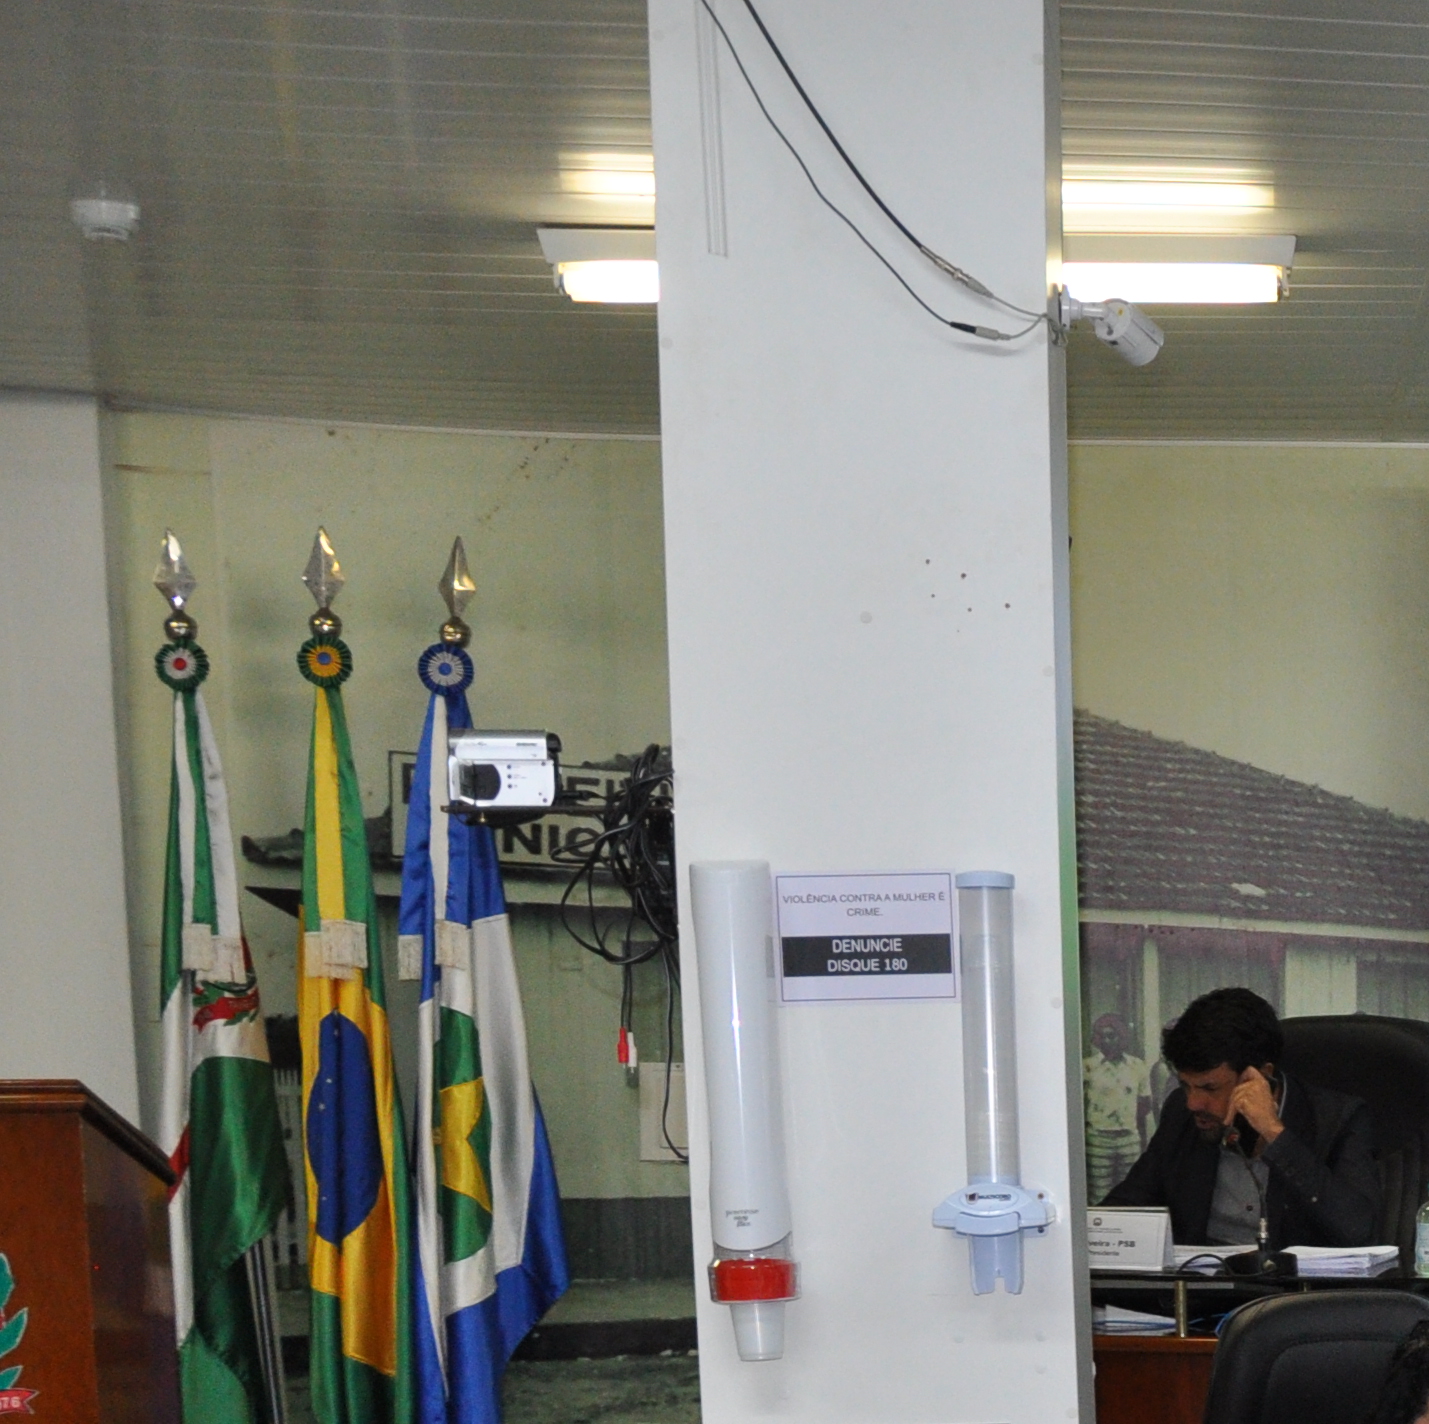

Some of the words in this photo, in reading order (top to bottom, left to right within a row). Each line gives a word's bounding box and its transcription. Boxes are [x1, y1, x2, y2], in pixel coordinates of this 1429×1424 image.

[783, 894, 836, 903] VIOLÊNCIA
[840, 894, 882, 902] CONTRA
[893, 892, 936, 901] MULHER
[939, 892, 944, 900] É
[847, 908, 883, 916] CRIME.
[832, 938, 902, 953] DENUNCIE
[827, 959, 880, 972] DISQUE
[884, 958, 907, 971] 180
